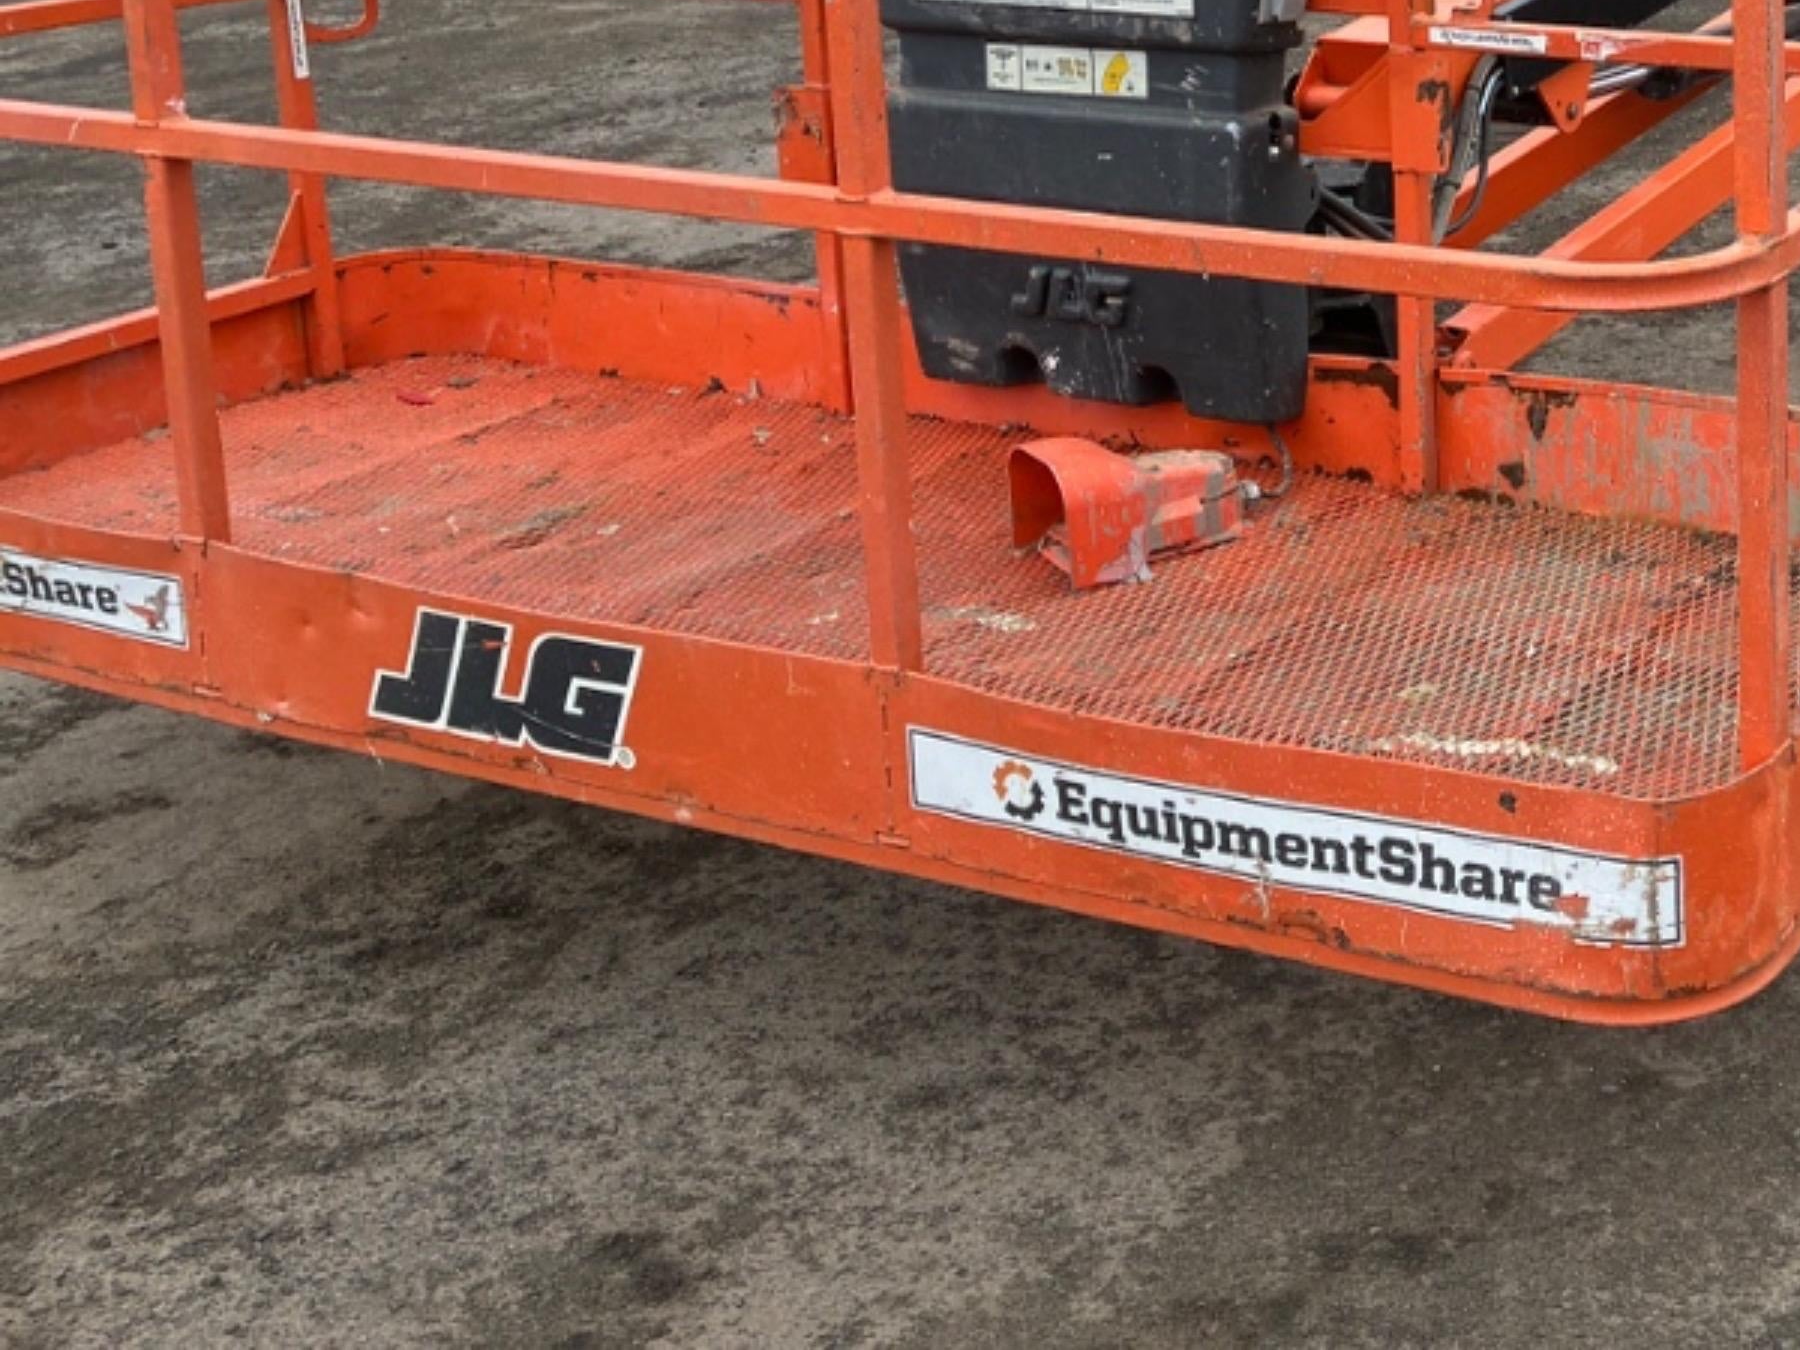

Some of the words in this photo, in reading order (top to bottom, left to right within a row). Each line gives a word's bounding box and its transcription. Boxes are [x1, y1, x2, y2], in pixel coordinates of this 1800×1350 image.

[1011, 265, 1133, 327] JLG
[0, 560, 118, 615] Share
[369, 605, 643, 768] JLG
[1053, 777, 1562, 912] EquipmentShare
